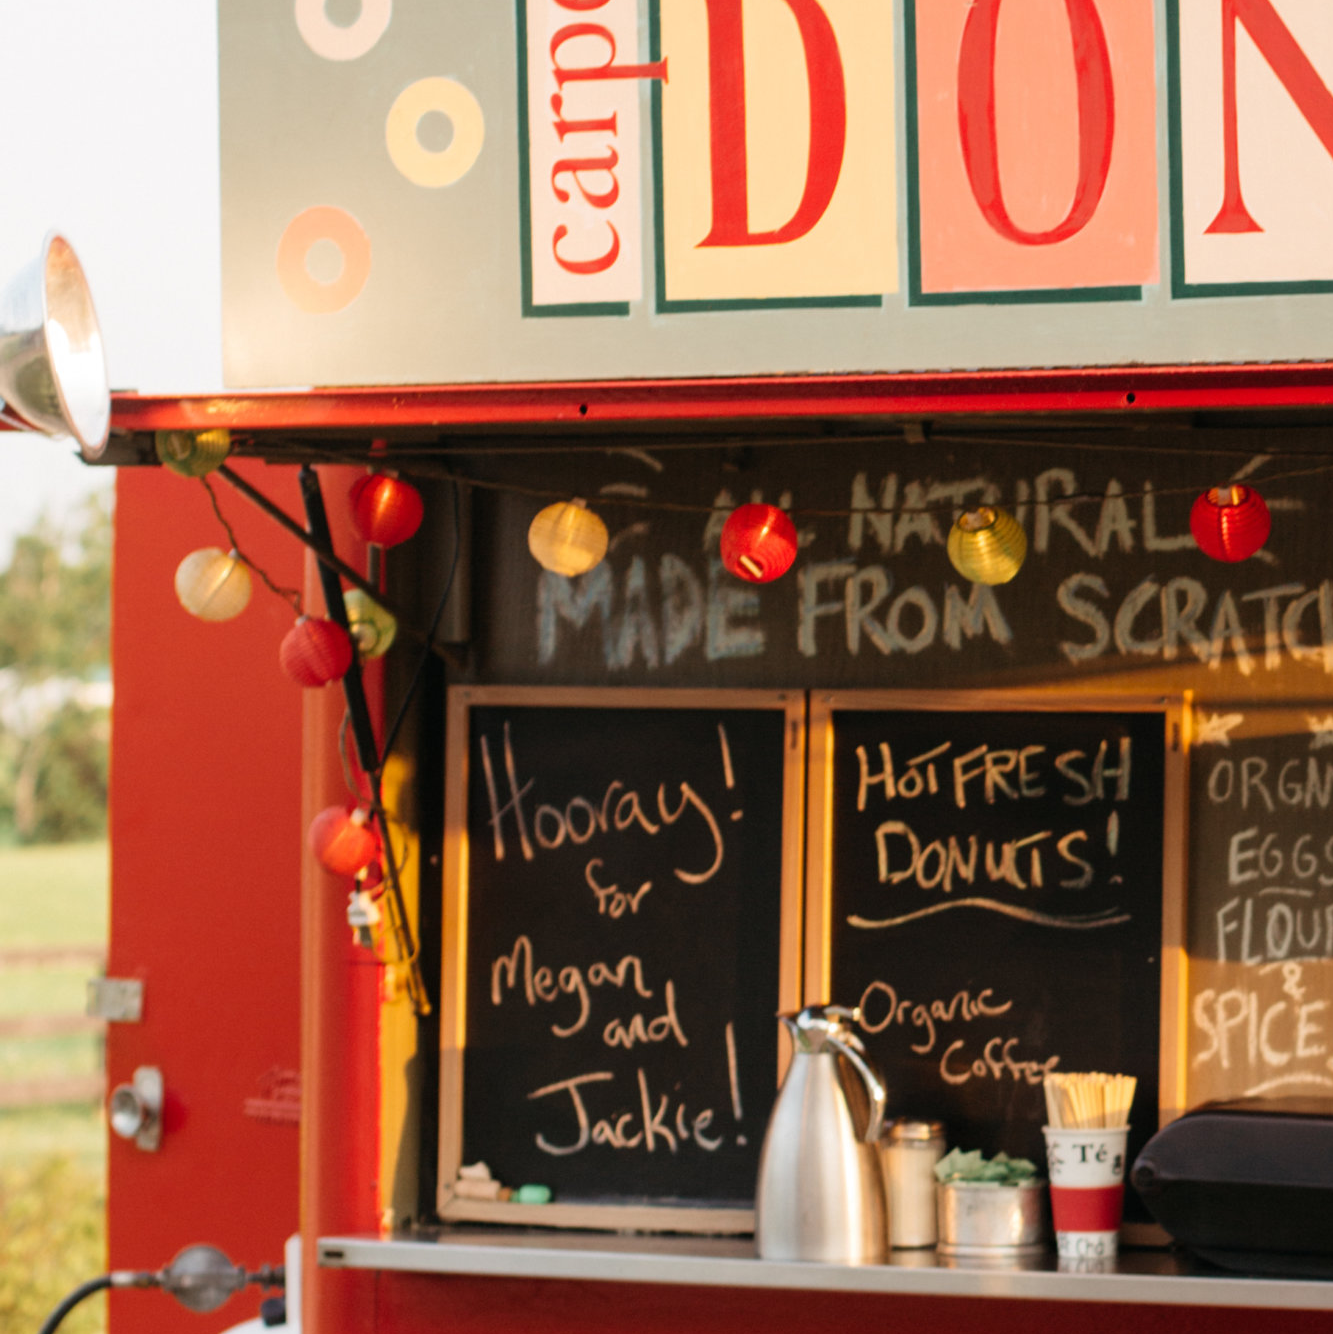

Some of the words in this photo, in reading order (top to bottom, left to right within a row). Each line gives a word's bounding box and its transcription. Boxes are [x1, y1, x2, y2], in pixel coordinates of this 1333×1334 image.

[537, 555, 765, 670] MADE
[798, 557, 1013, 657] FROM
[480, 720, 744, 884] Hooray!
[585, 859, 652, 918] for
[491, 935, 652, 1037] Megan
[603, 980, 688, 1049] and
[859, 980, 1013, 1055] Organic
[527, 1022, 747, 1155] Jackie!
